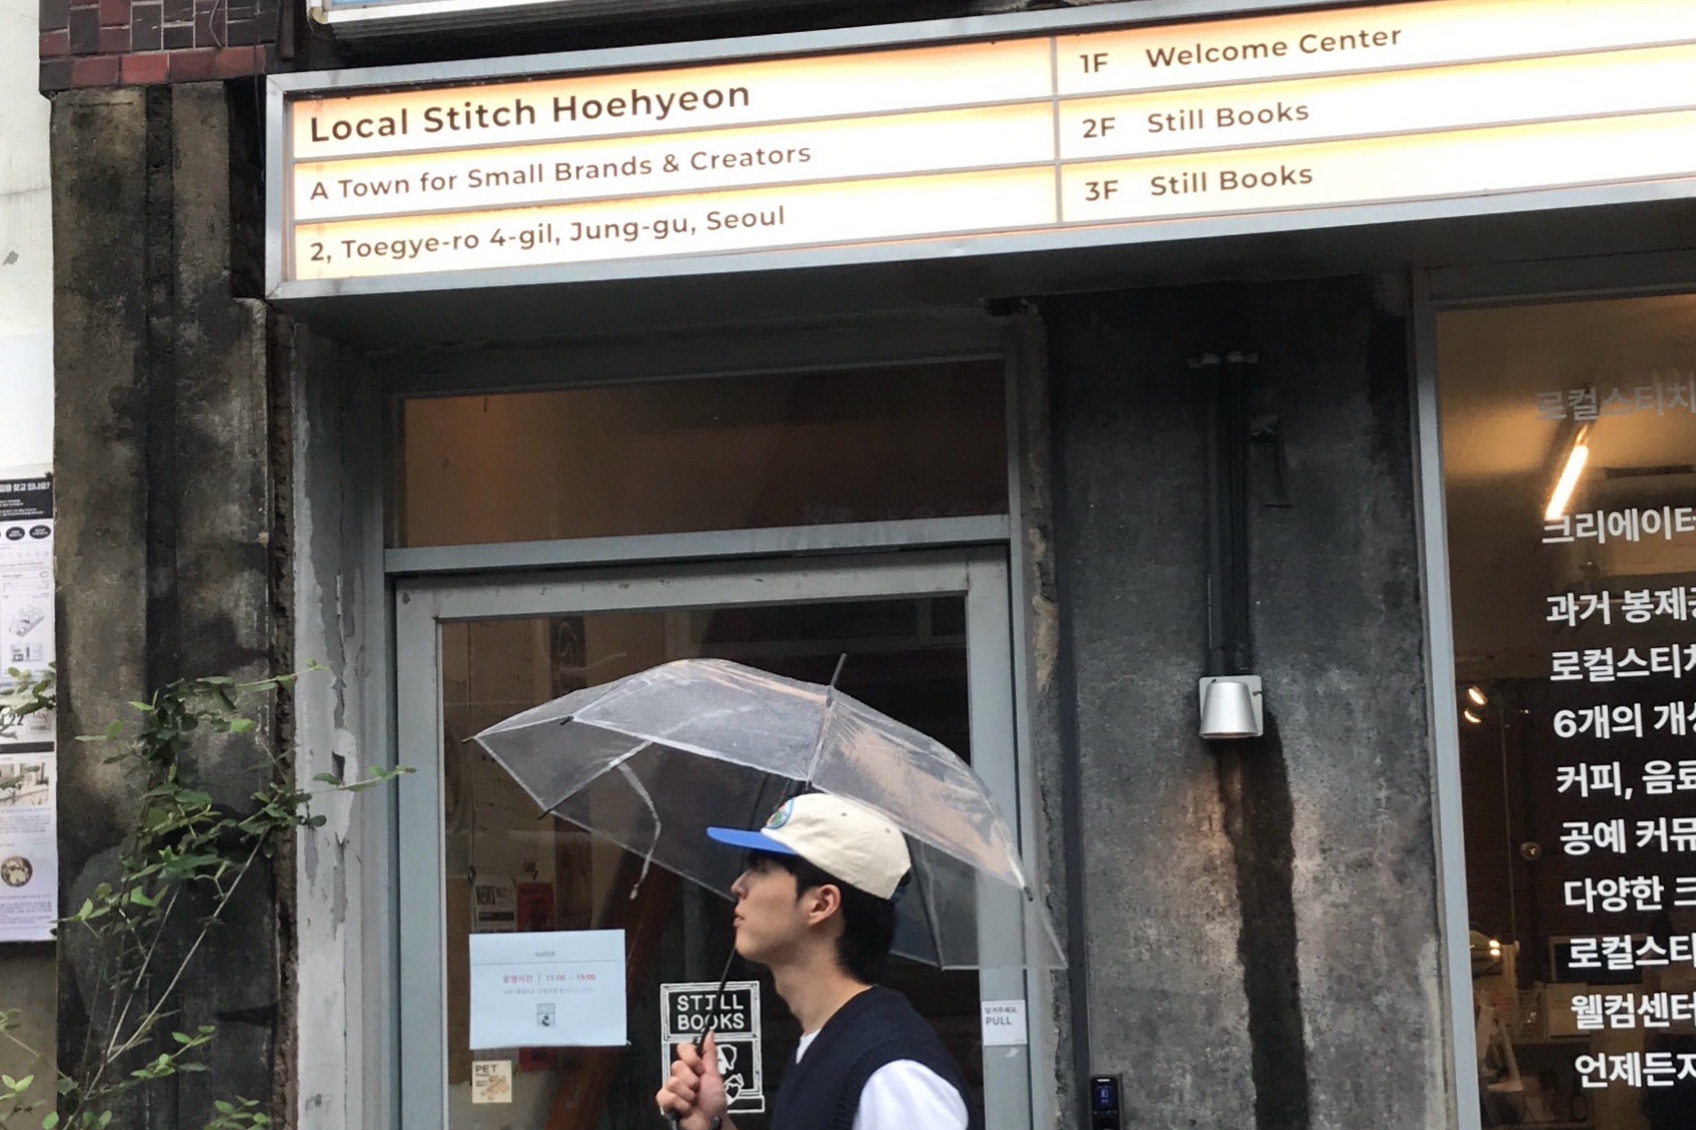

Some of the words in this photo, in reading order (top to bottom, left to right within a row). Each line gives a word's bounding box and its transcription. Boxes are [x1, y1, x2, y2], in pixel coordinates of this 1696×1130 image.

[1080, 52, 1108, 73] 1F
[1145, 41, 1288, 68] Welcome
[1299, 30, 1401, 54] Center
[311, 108, 407, 142] Local
[424, 98, 535, 133] Stitch
[553, 87, 749, 122] Hoehyeon
[1082, 117, 1115, 139] 2F
[1148, 109, 1203, 133] Still
[1217, 102, 1309, 128] Books
[310, 181, 329, 200] A
[338, 178, 409, 198] Town
[420, 172, 456, 192] for
[468, 163, 543, 188] Small
[555, 156, 652, 181] Brands
[663, 154, 680, 173] &
[691, 148, 811, 171] Creators
[1085, 180, 1118, 201] 3F
[1151, 171, 1207, 196] Still
[1220, 165, 1313, 191] Books
[311, 242, 332, 263] 2,
[341, 234, 479, 260] Toegye-ro
[490, 223, 560, 250] 4-gil,
[570, 218, 696, 243] Jung-gu,
[707, 205, 784, 231] Seoul
[1546, 591, 1611, 627] 과거
[1553, 702, 1644, 739] 6개의
[1653, 700, 1696, 736] 개
[1556, 761, 1634, 800] 커피,
[1560, 818, 1627, 856] 공예
[1563, 875, 1665, 913] 다양한
[677, 993, 744, 1012] STILL
[677, 1012, 745, 1031] BOOKS
[985, 1016, 1012, 1026] PULL
[1570, 991, 1696, 1030] 웰컴센터
